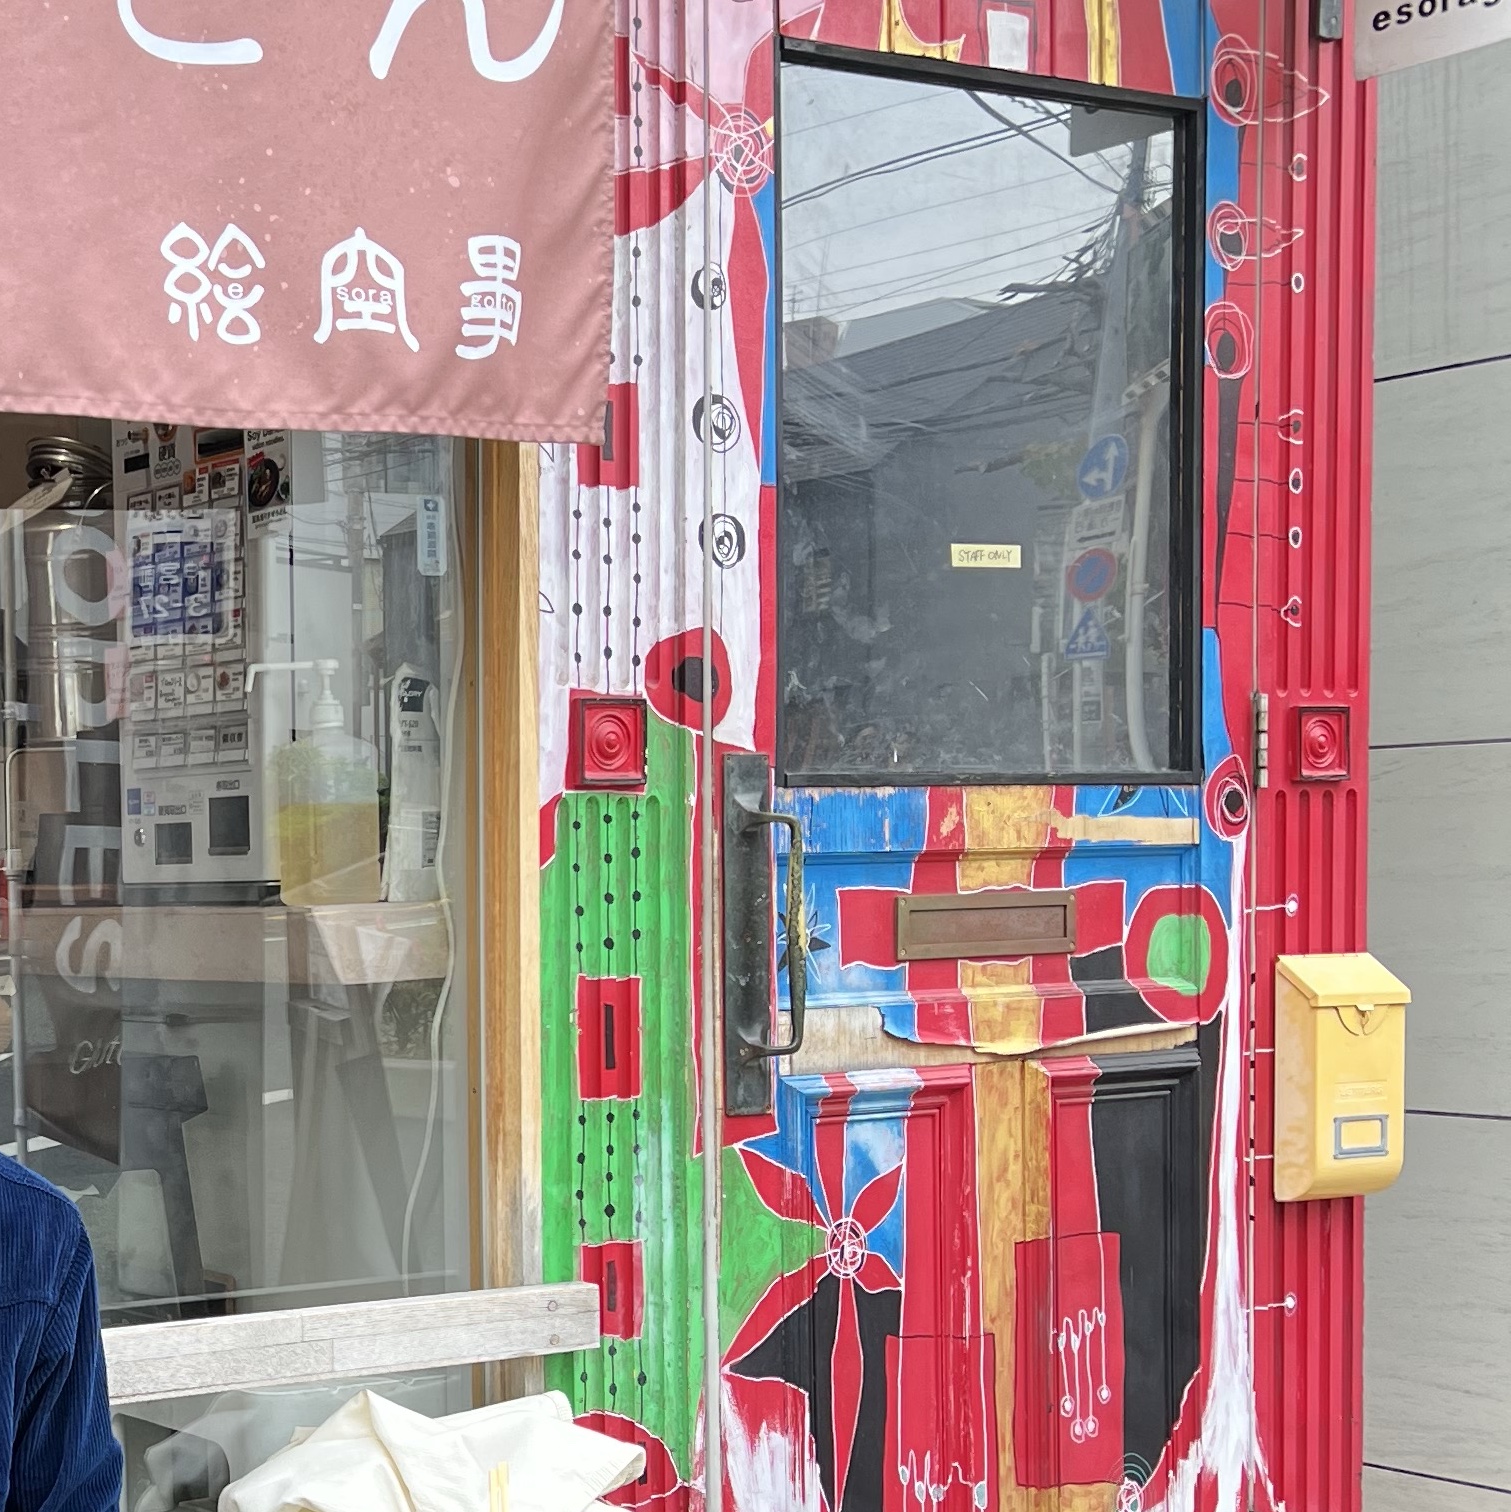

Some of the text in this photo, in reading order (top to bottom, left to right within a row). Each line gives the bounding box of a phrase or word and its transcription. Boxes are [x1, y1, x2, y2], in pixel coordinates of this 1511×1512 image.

[1372, 0, 1500, 31] eso
[336, 286, 393, 305] sora
[958, 549, 1013, 562] STAFF ONLY
